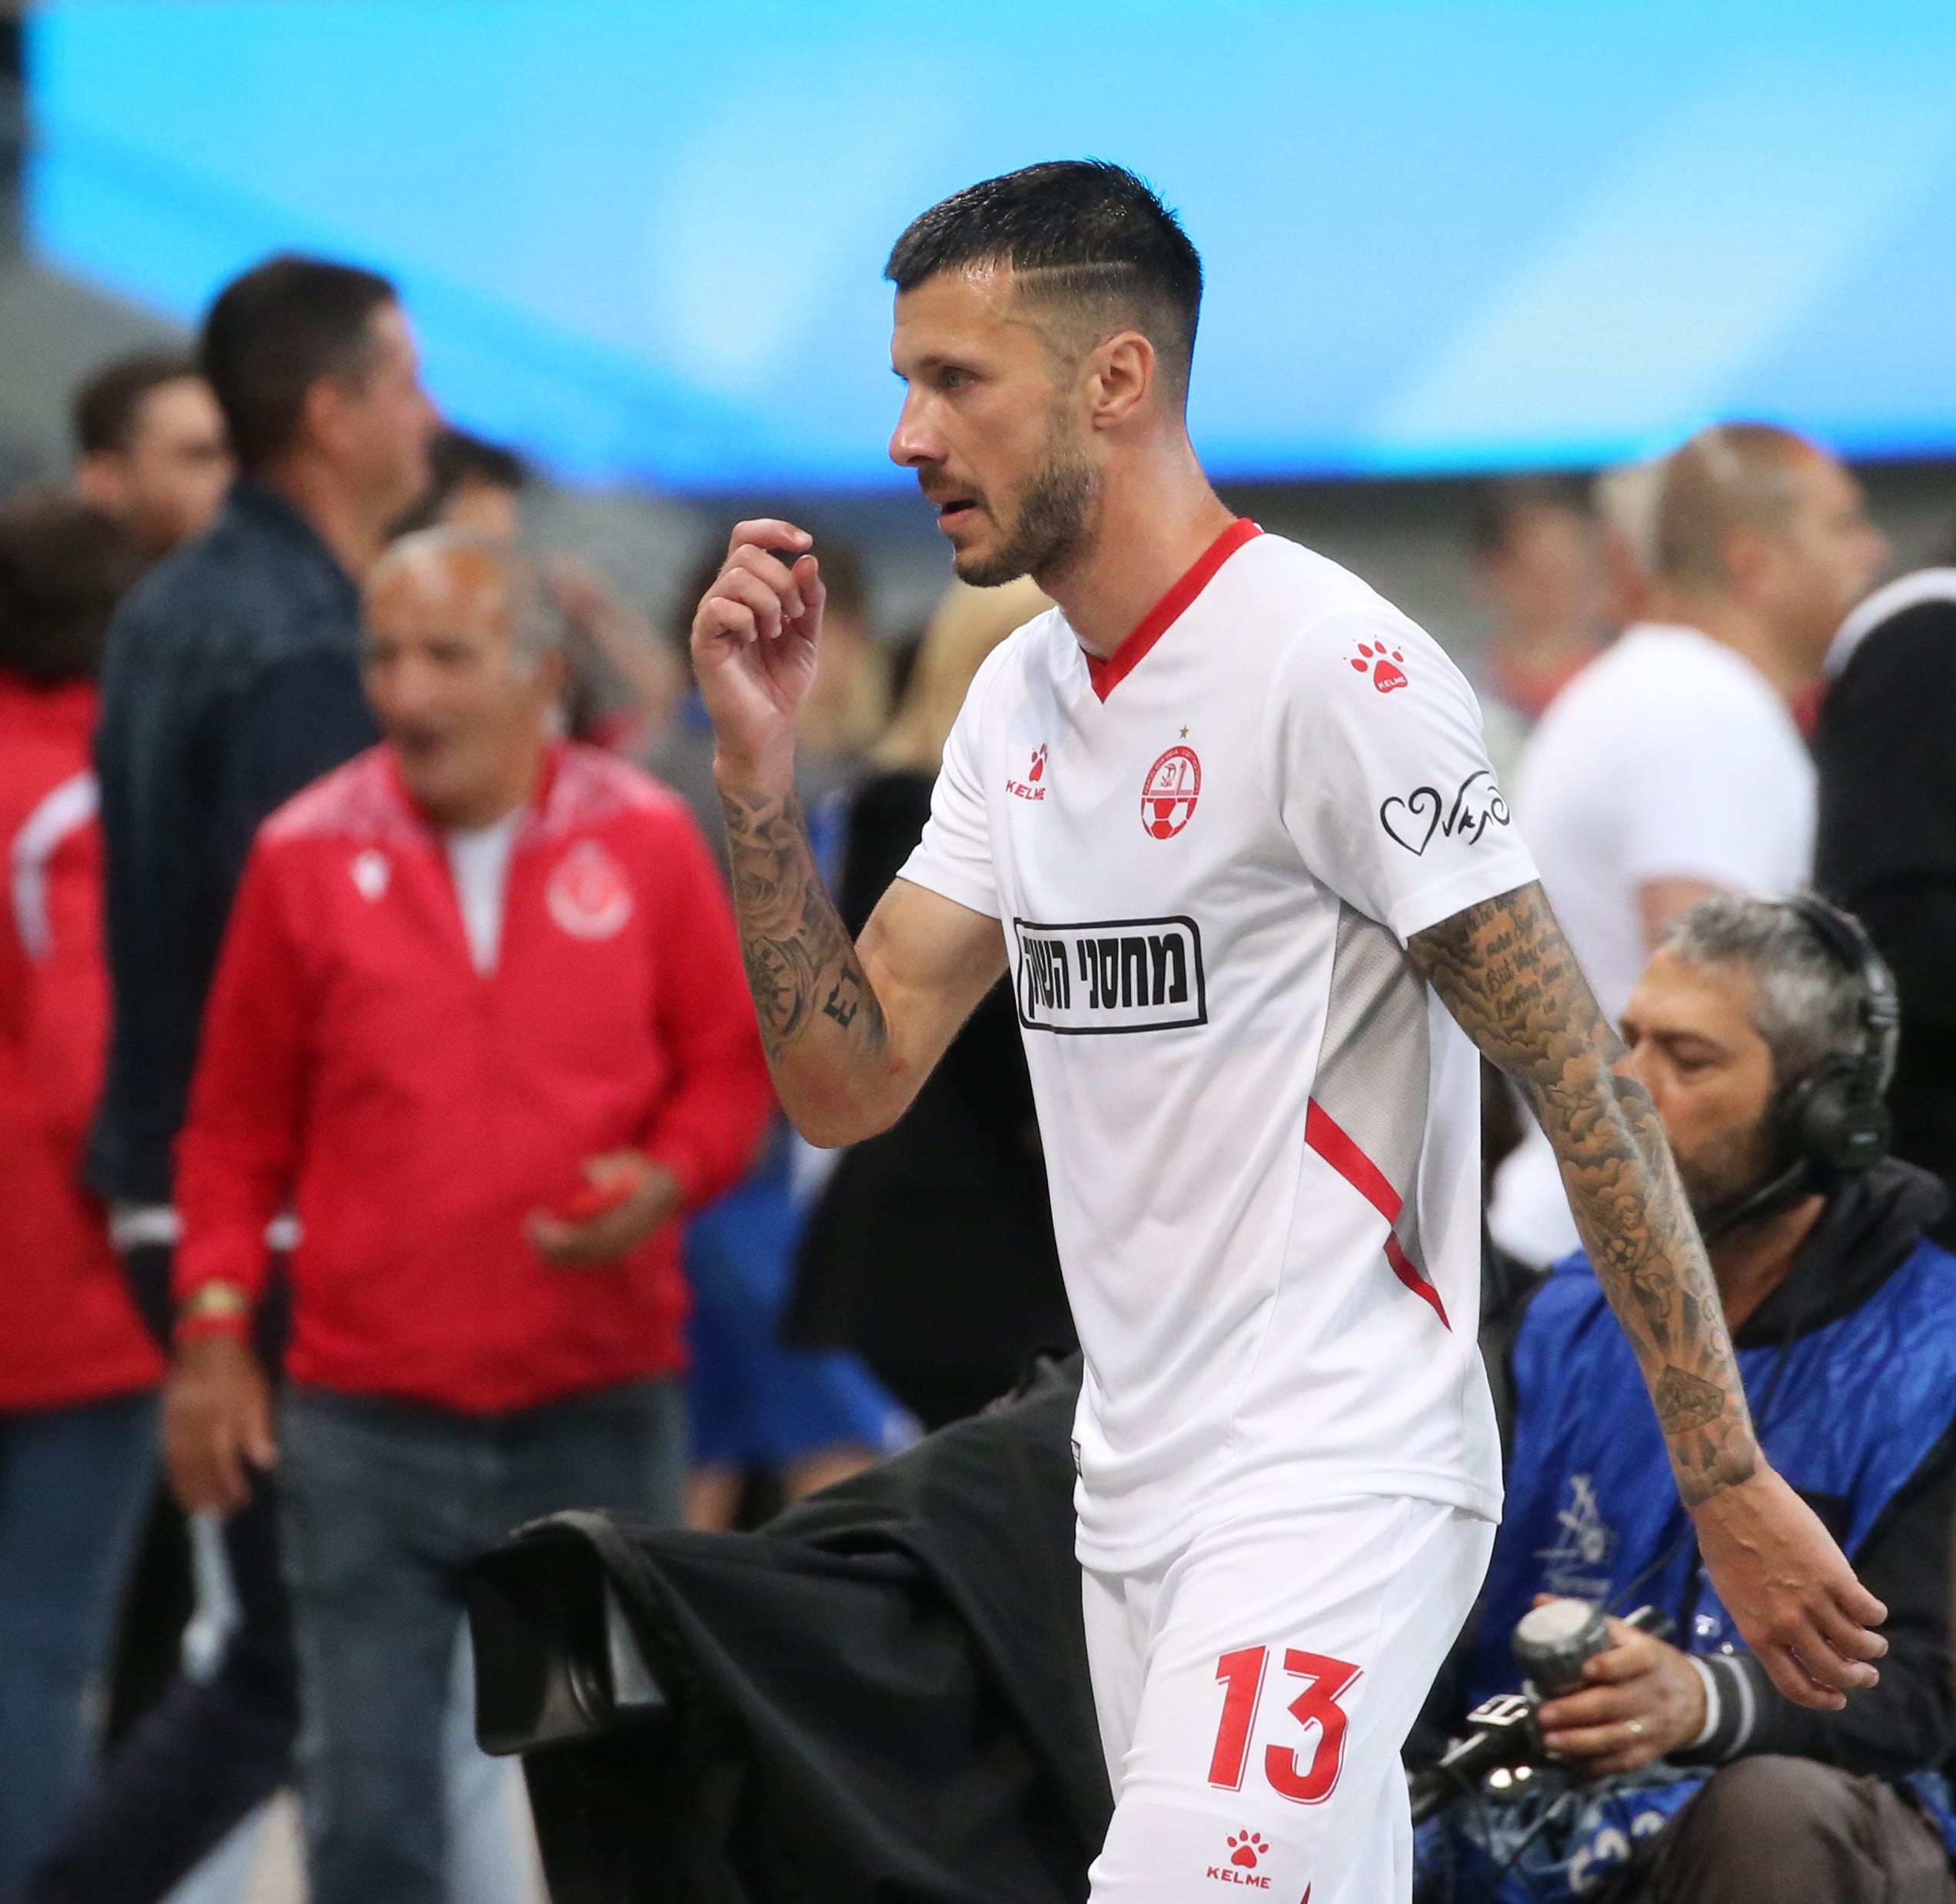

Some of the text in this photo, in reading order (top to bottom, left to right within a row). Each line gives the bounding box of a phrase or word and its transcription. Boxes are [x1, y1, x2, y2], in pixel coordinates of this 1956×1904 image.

[1377, 676, 1406, 690] KELME
[1022, 933, 1189, 1020] מחסני השוק
[1207, 1644, 1364, 1806] 13
[1206, 1866, 1272, 1889] KELME
